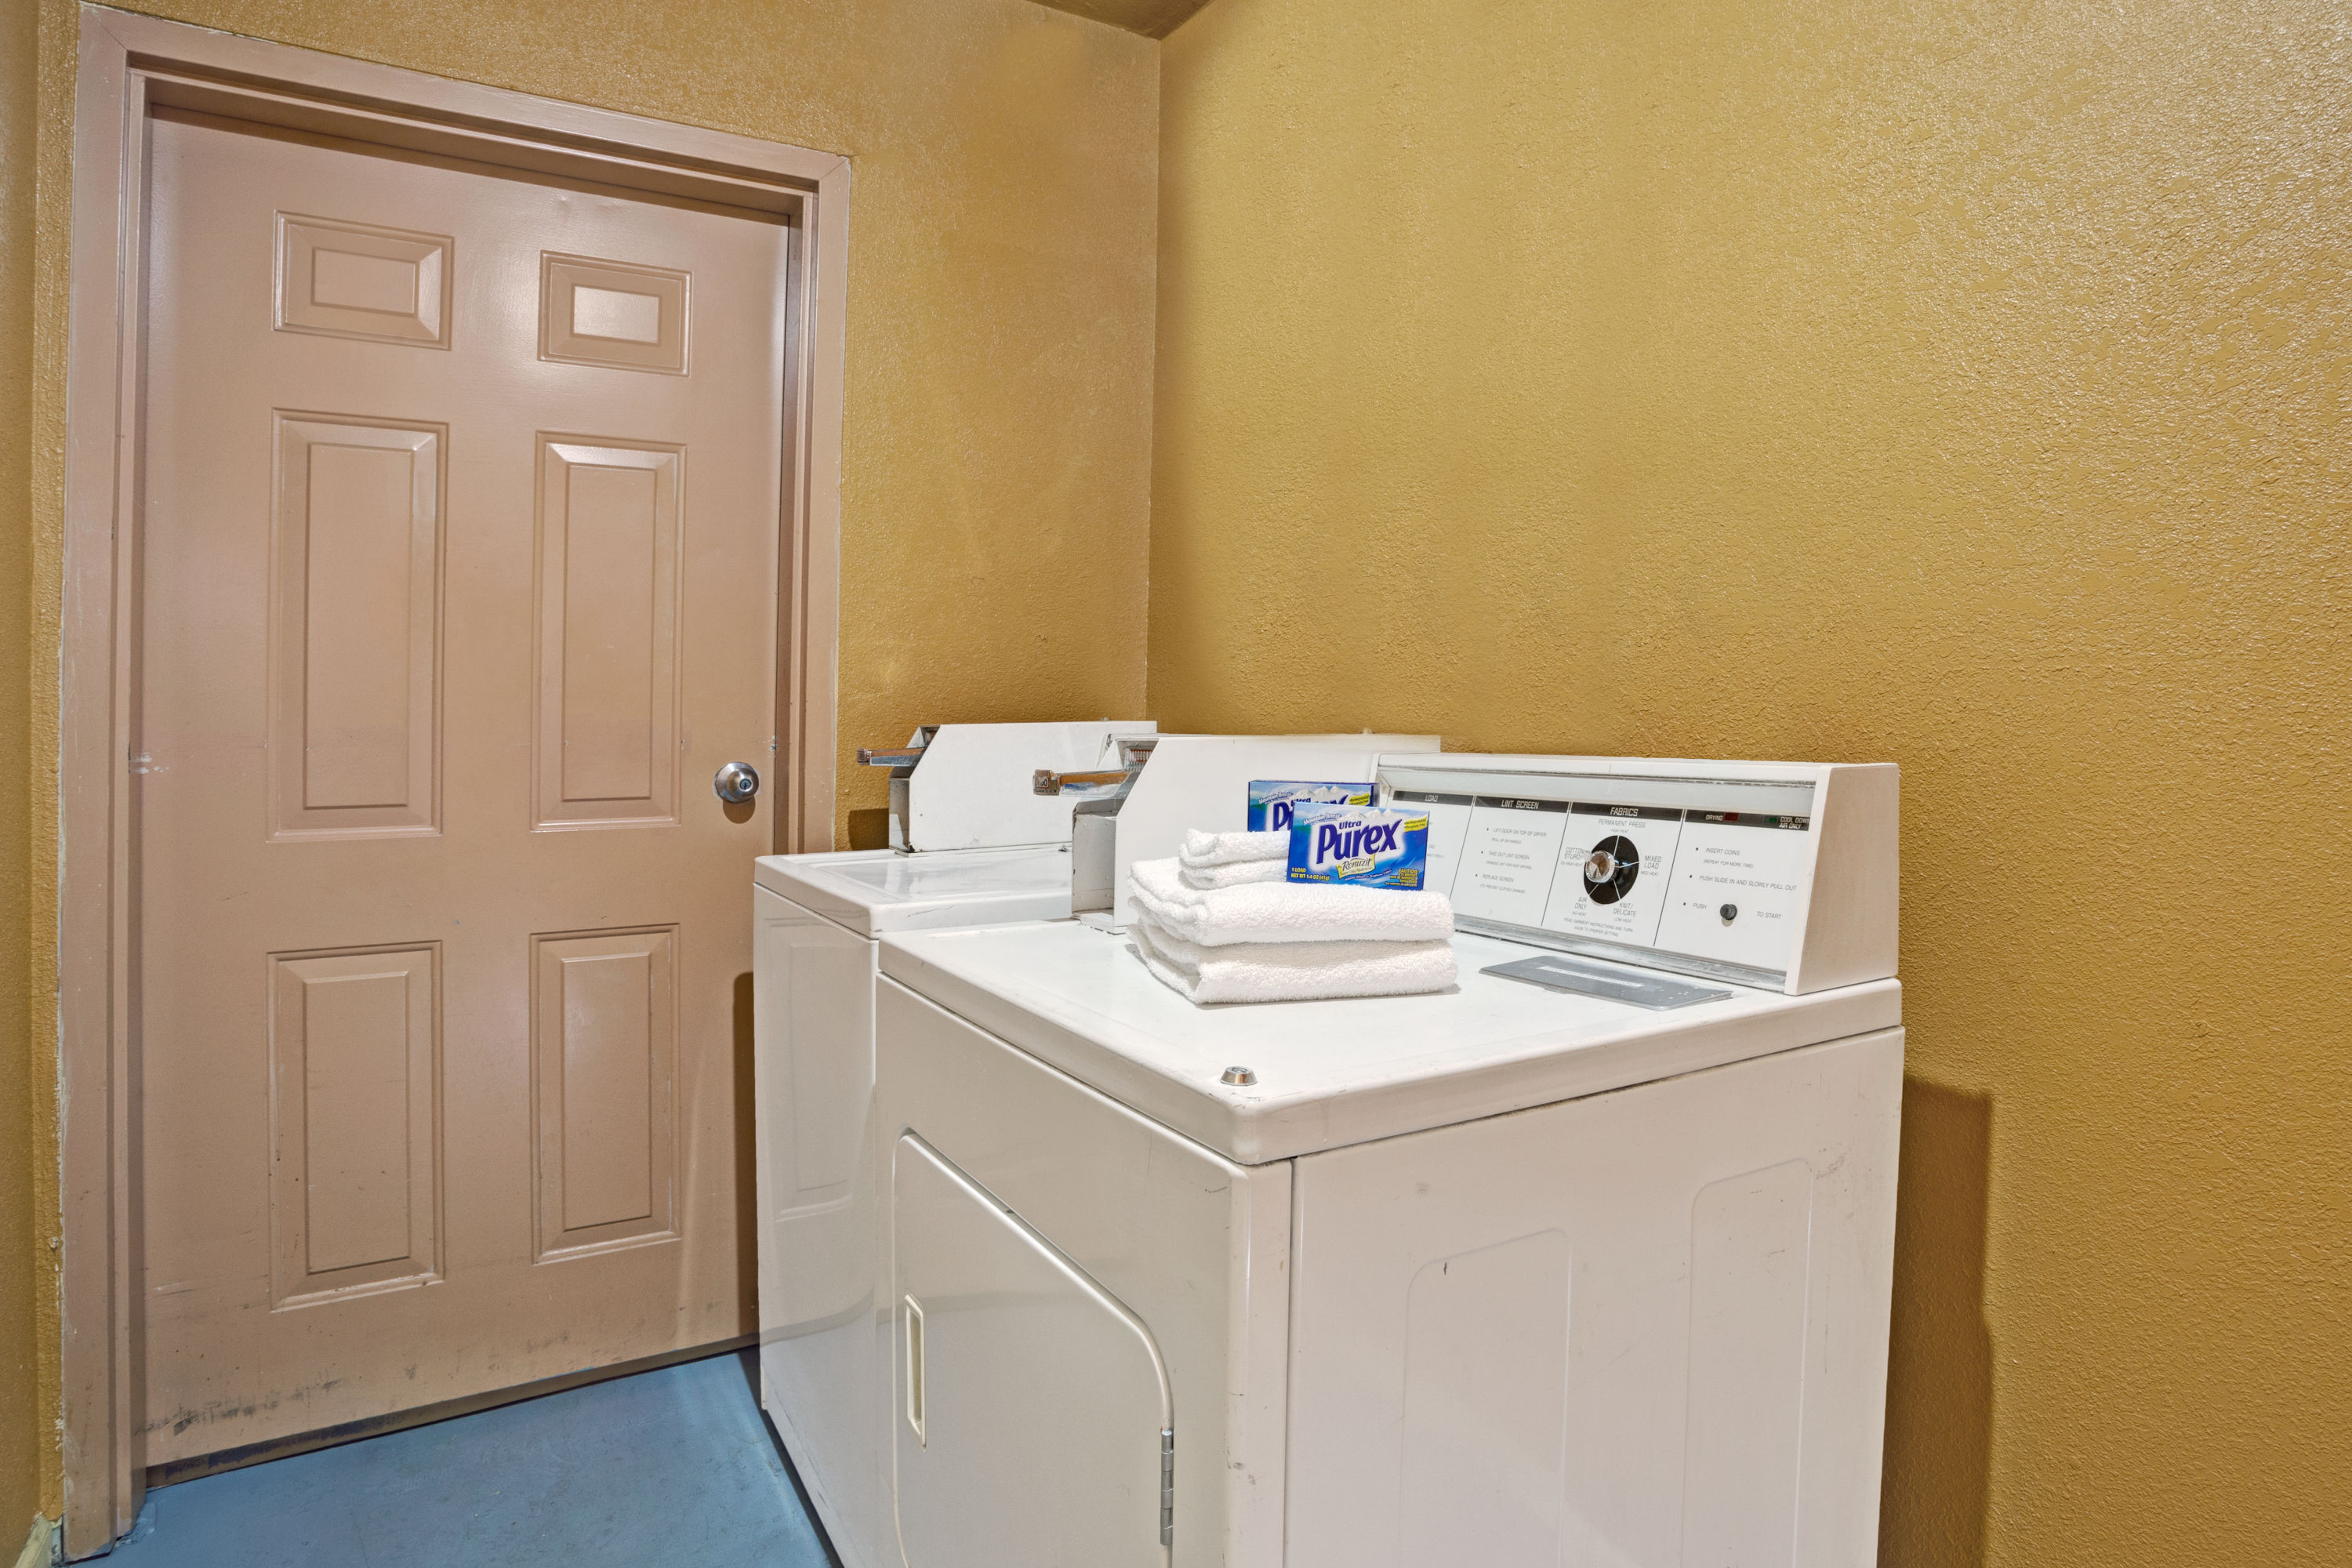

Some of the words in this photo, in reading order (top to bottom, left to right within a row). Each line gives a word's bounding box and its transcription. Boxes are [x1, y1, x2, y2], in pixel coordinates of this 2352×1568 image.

[1425, 794, 1438, 803] LOAD
[1501, 800, 1514, 808] LINT
[1516, 800, 1539, 810] SCREEN
[1610, 807, 1639, 817] FABRICS
[1338, 821, 1362, 830] Ultra
[1598, 818, 1628, 827] PERMANENT
[1316, 818, 1403, 865] Purex
[1644, 855, 1662, 863] MIXED
[1342, 858, 1372, 871] Renuzit
[1613, 908, 1638, 917] DELICATE
[1590, 921, 1615, 930] INSTRUCTIONS
